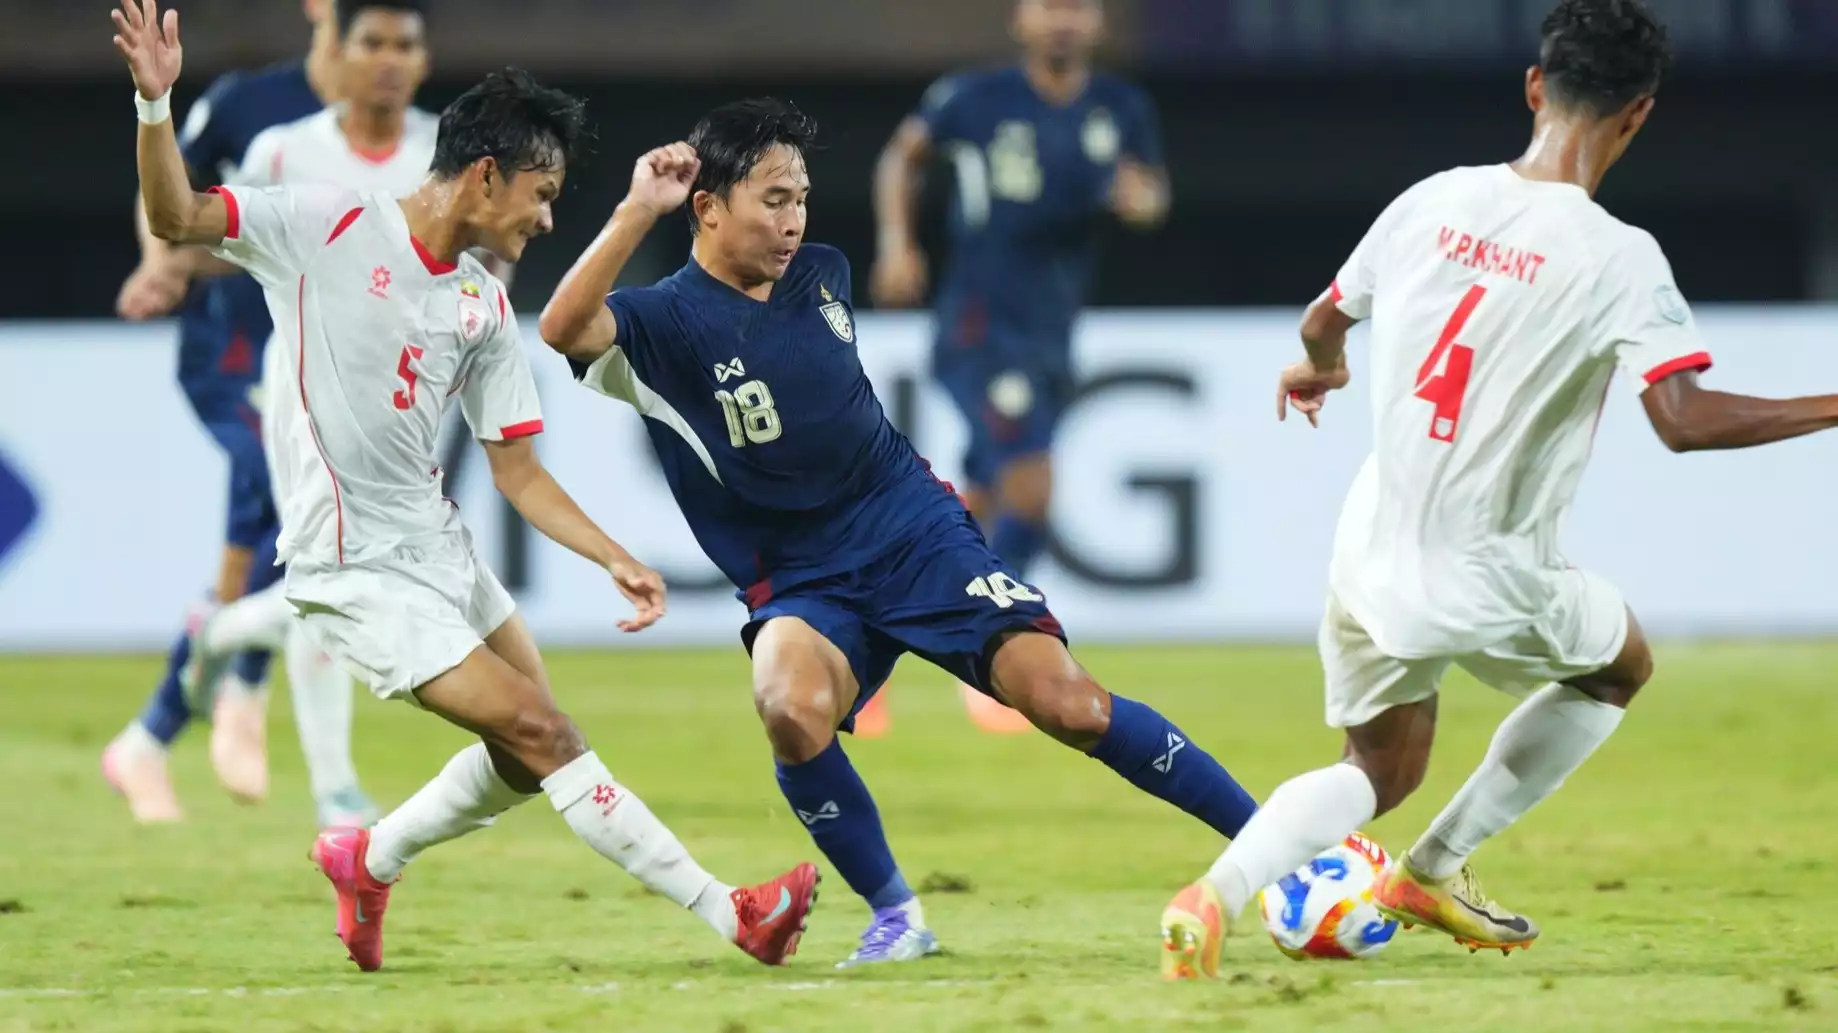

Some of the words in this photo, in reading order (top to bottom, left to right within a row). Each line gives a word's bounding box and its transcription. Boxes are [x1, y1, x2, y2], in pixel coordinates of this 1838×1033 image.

[393, 343, 424, 410] 5
[1414, 283, 1487, 443] 4
[714, 379, 782, 448] 18
